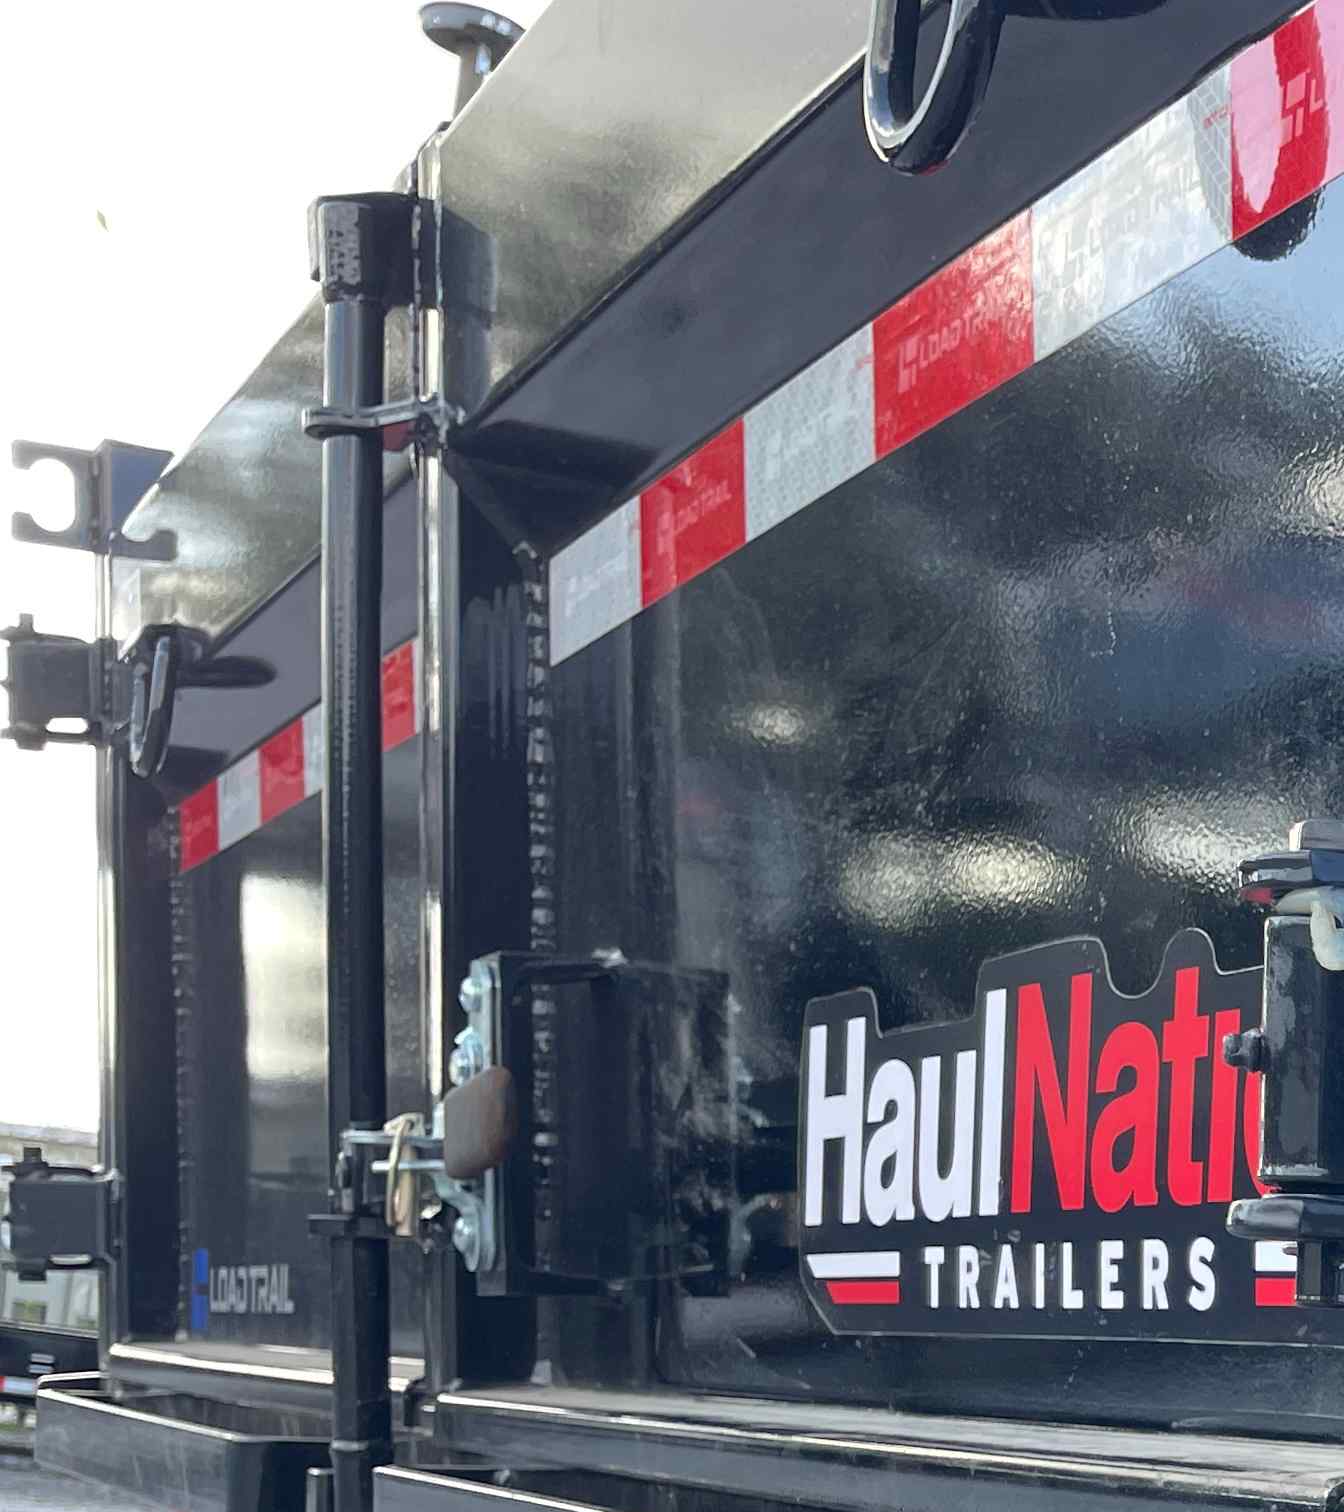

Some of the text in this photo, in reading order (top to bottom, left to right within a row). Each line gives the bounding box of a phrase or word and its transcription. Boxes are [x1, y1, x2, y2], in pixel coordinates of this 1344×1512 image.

[210, 1263, 295, 1315] LOAD TRAIL
[922, 1236, 1217, 1312] TRAILERS
